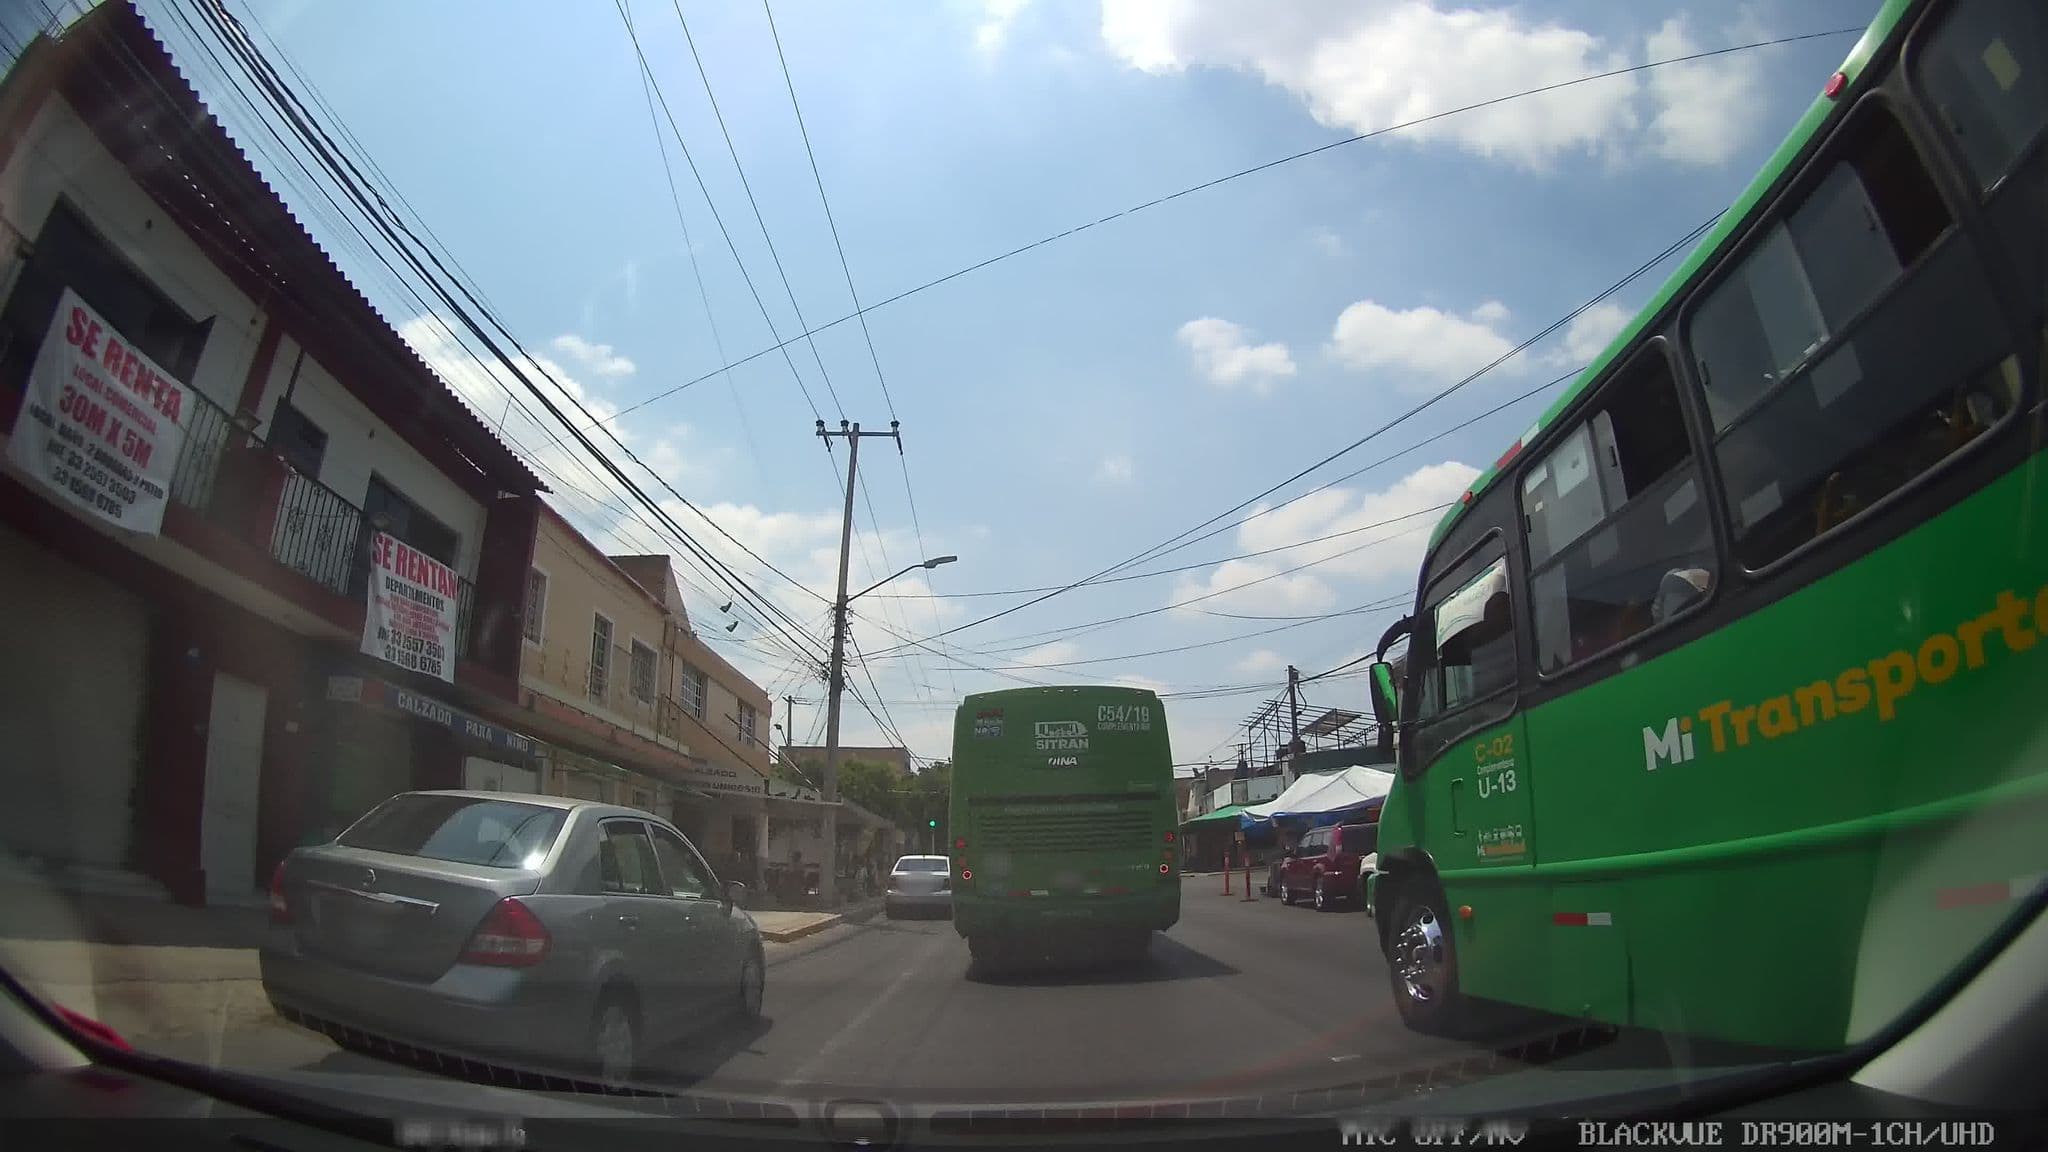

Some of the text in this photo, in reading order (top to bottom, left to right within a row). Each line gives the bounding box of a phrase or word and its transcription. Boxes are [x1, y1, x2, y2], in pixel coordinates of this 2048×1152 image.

[66, 306, 182, 423] SE RENTA
[59, 384, 154, 470] 30M X 5M
[372, 532, 459, 599] SE RENTAN
[385, 576, 445, 612] DEPARTAMENTOS
[398, 692, 452, 727] CALZADO
[1036, 738, 1089, 750] SITRAN
[1475, 734, 1513, 763] C-02
[1643, 716, 1695, 771] Mi
[1478, 769, 1516, 799] U-13
